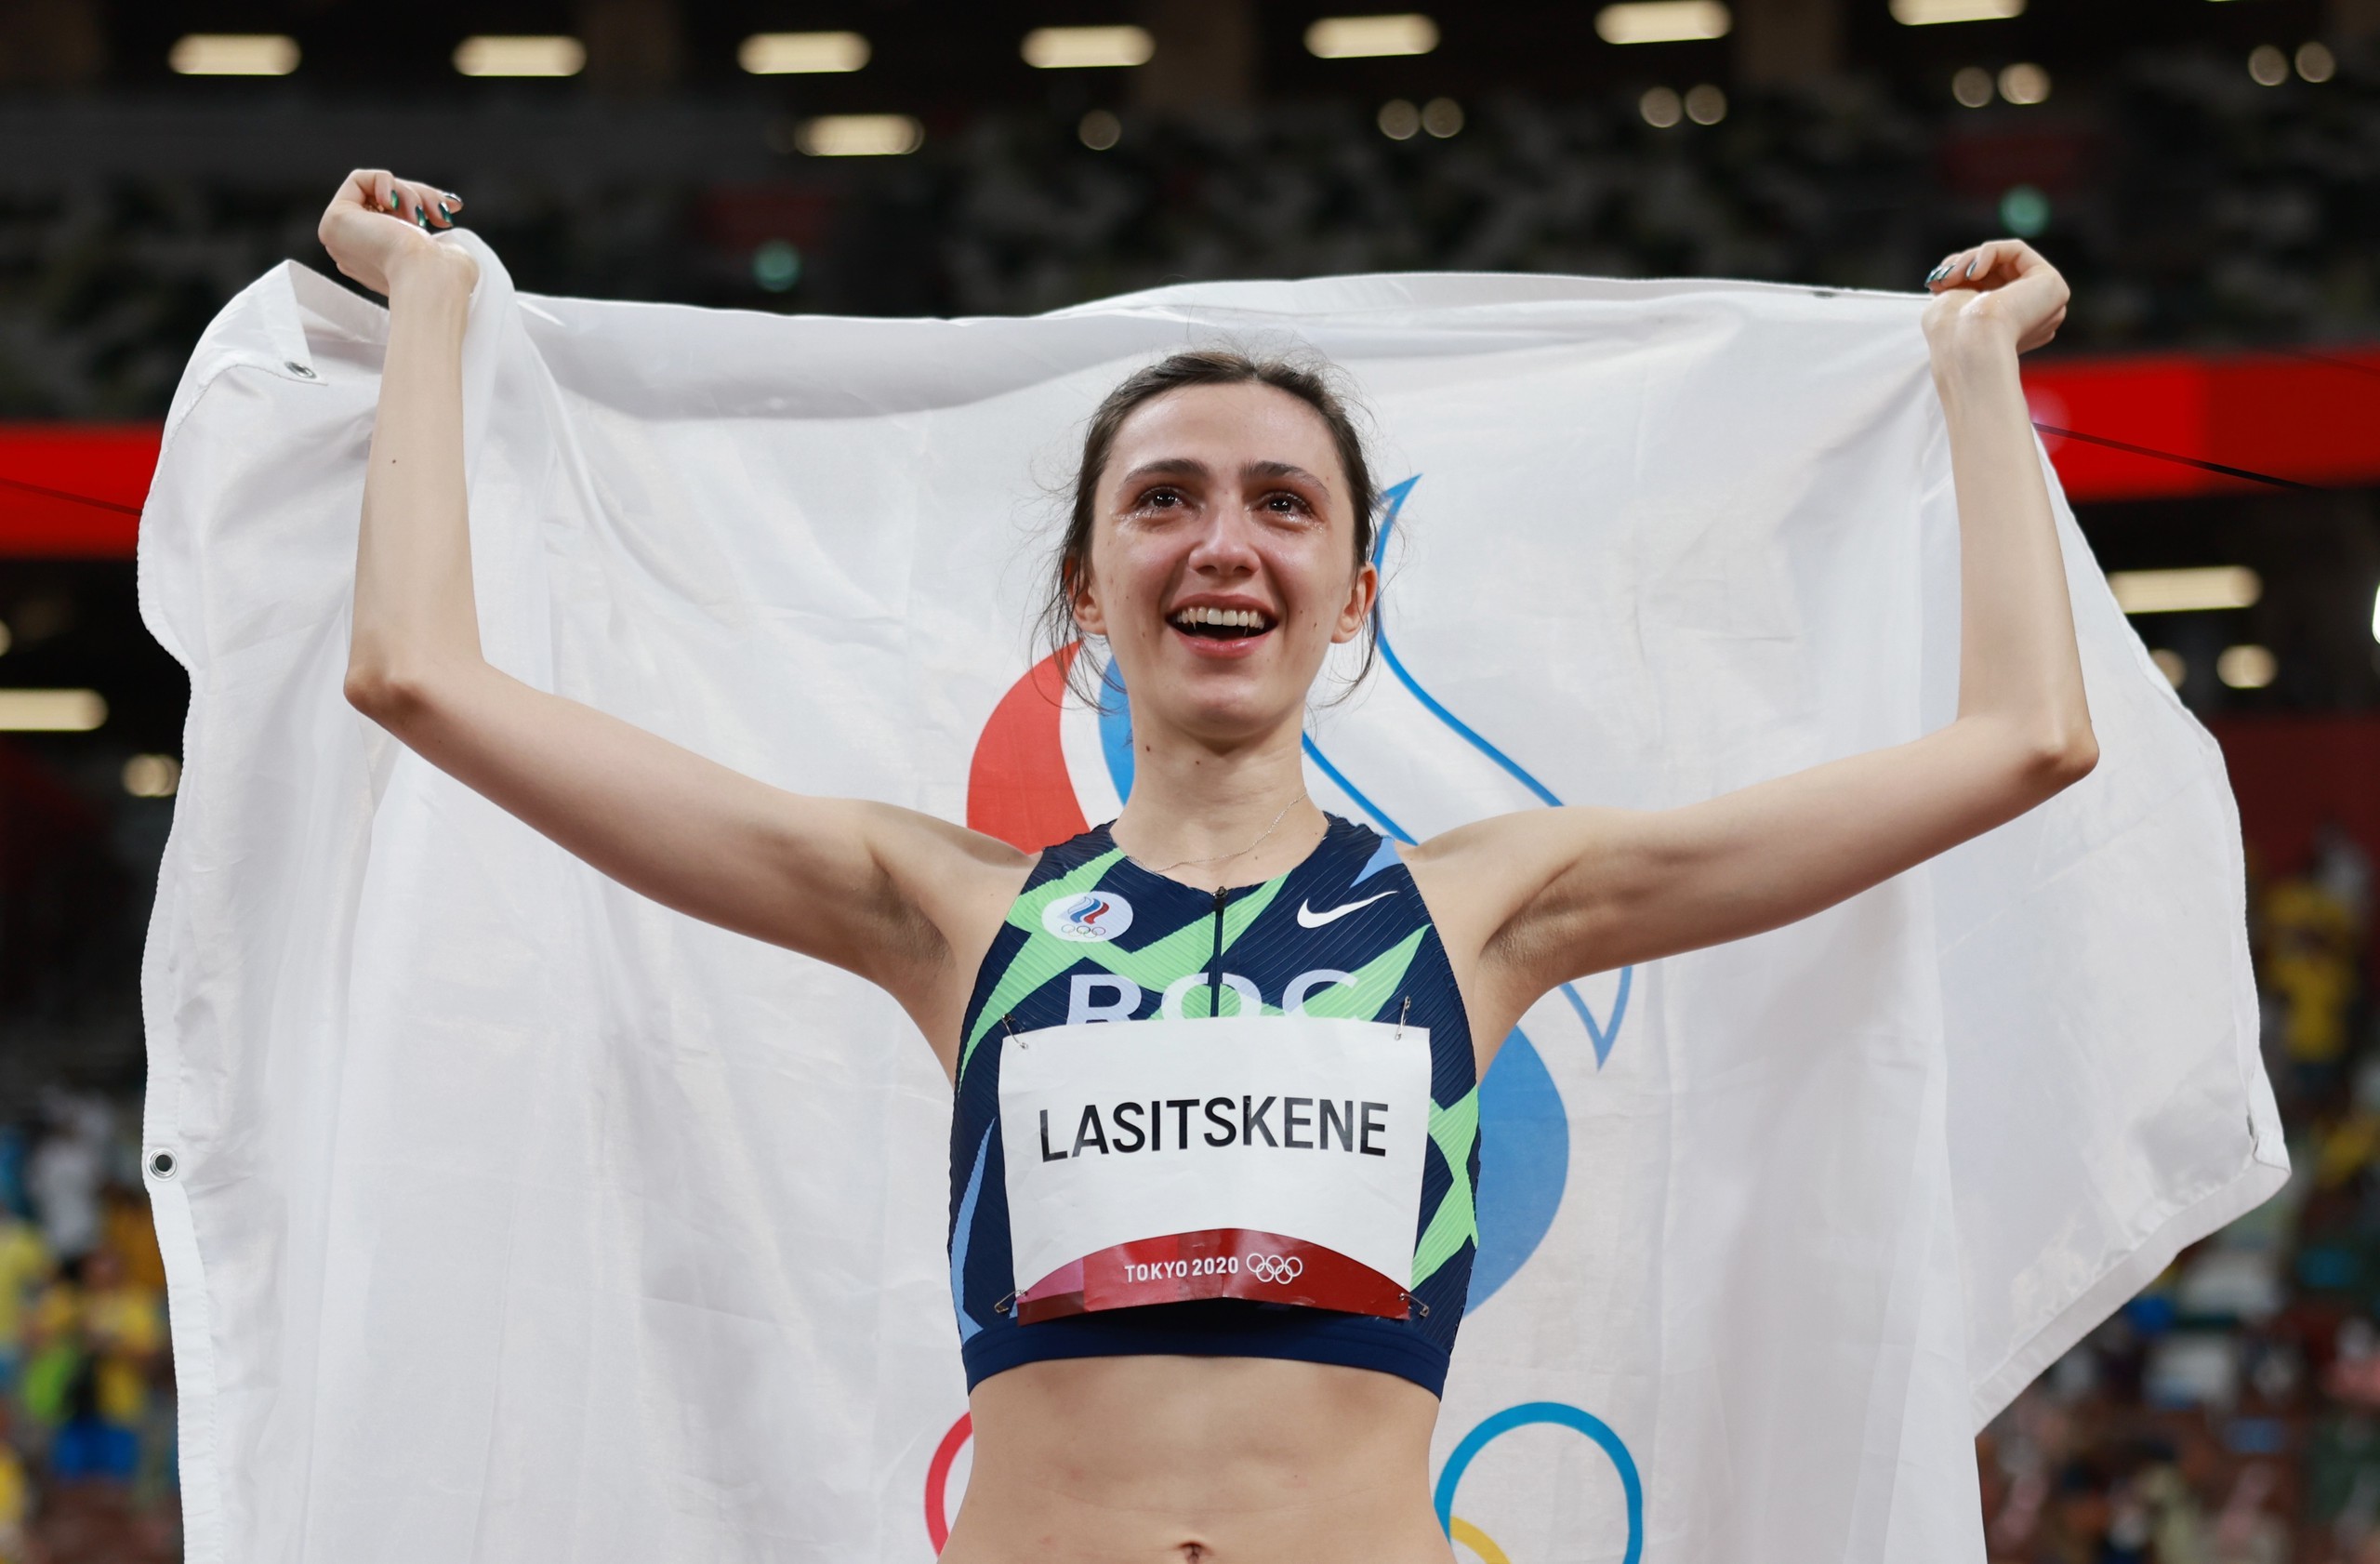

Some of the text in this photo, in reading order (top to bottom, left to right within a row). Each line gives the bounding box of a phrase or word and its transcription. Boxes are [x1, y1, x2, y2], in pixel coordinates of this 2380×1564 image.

[1039, 1095, 1389, 1162] LASITSKENE
[1124, 1257, 1239, 1283] TOKYO 2020
